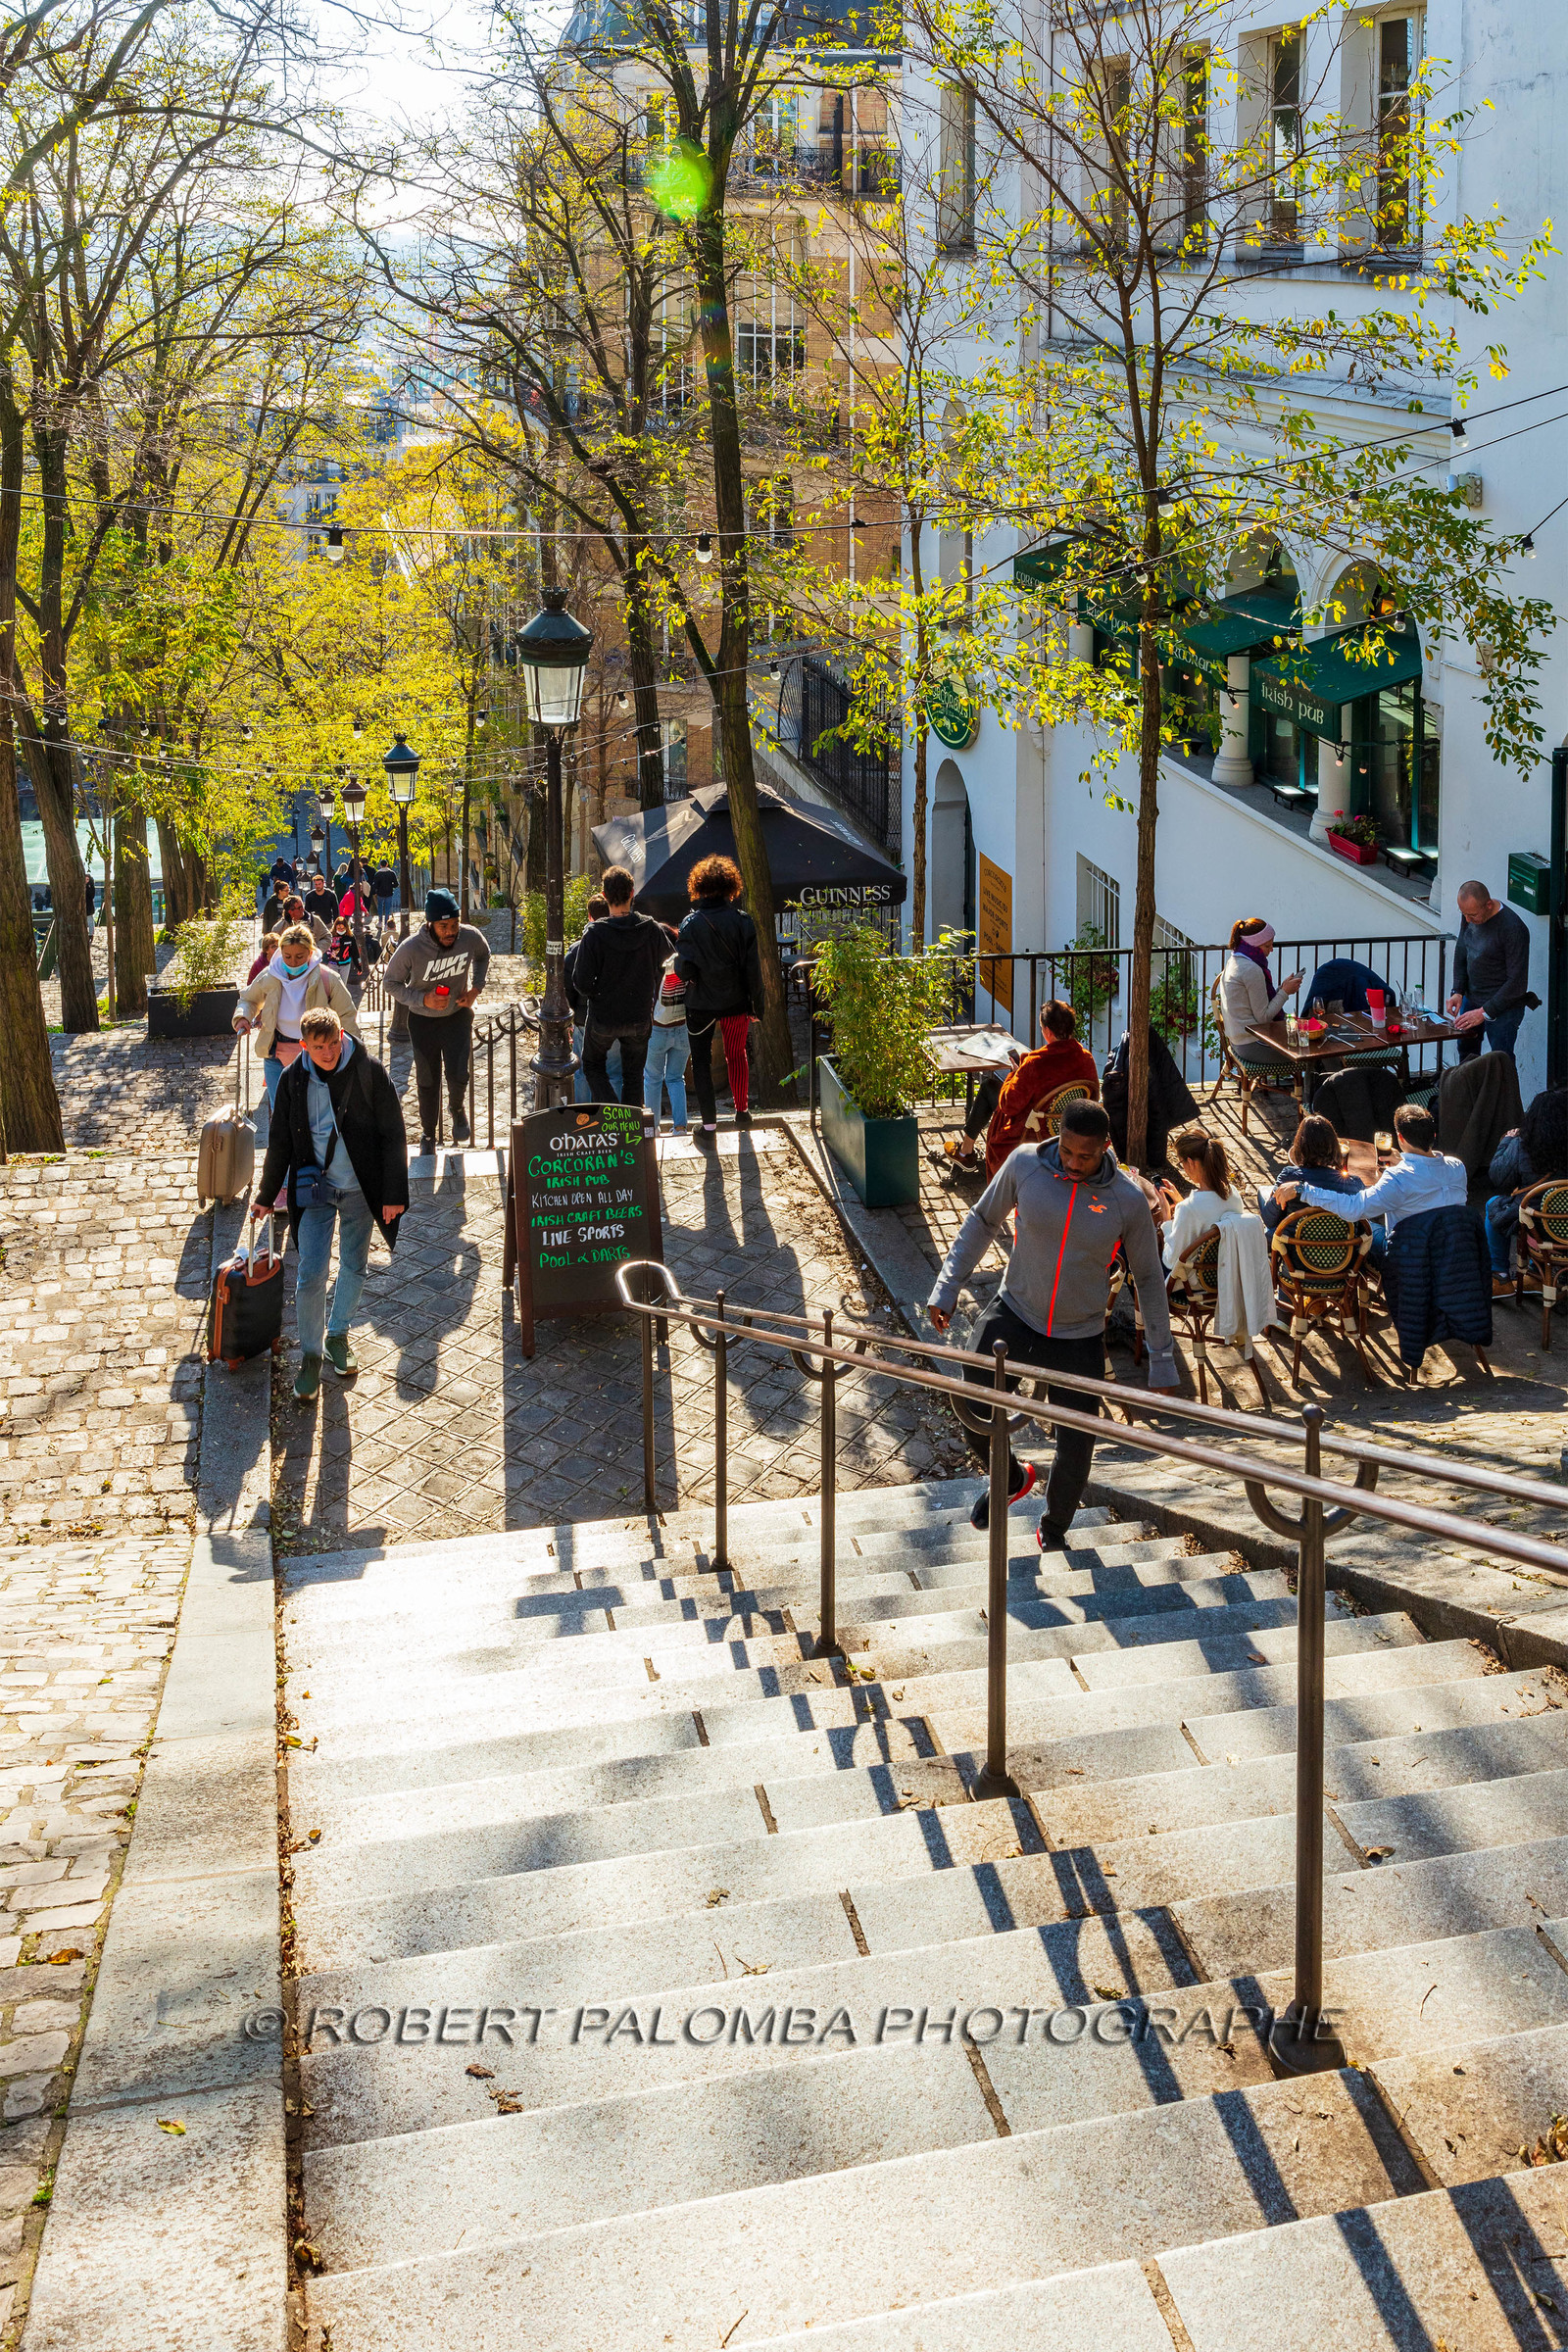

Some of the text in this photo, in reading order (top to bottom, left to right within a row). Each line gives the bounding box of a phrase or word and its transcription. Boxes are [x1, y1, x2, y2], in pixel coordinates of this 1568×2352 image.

[800, 884, 891, 906] GUINNESS
[422, 953, 468, 982] NIKE
[603, 1105, 632, 1121] SCAN
[601, 1120, 640, 1132] OUR MENU
[528, 1150, 635, 1177] CORCORAN'S
[546, 1174, 610, 1189] IRISH PUB
[531, 1189, 633, 1208] KITCHEN OPEN ALL DAY
[531, 1205, 643, 1228] IRISH CRAFT BEERS
[542, 1223, 625, 1247] LIVE SPORTS
[539, 1250, 575, 1268] POOL
[590, 1245, 631, 1263] DARTS
